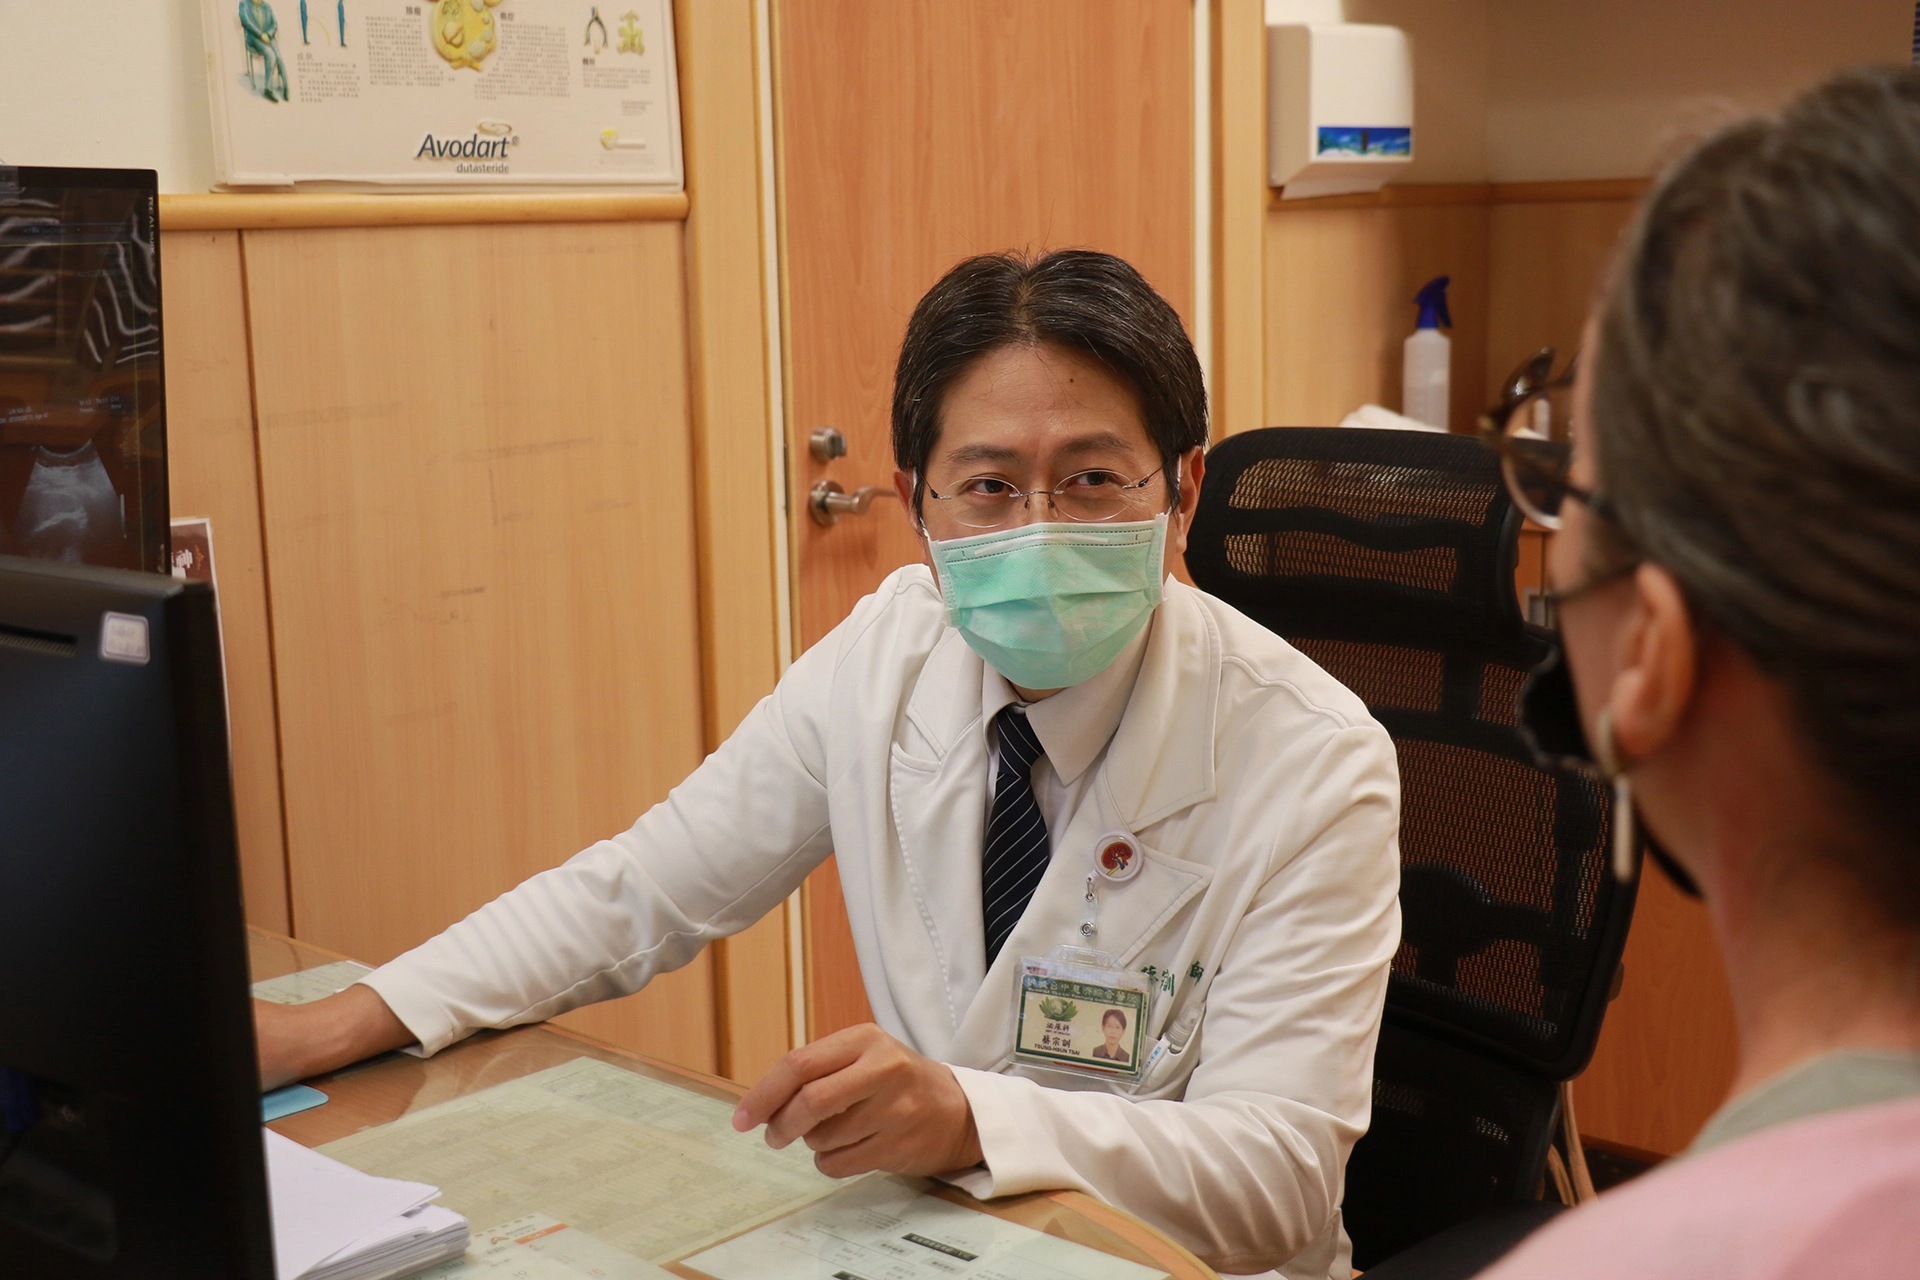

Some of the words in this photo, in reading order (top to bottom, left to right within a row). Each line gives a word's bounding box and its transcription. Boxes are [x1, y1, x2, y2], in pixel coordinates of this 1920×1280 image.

[416, 133, 508, 159] Avodart
[456, 163, 510, 174] dutasteride
[1046, 1022, 1070, 1032] 泌尿科
[1042, 1034, 1071, 1048] 蔡宗訓
[1034, 1043, 1068, 1054] TSUNG-HSUN
